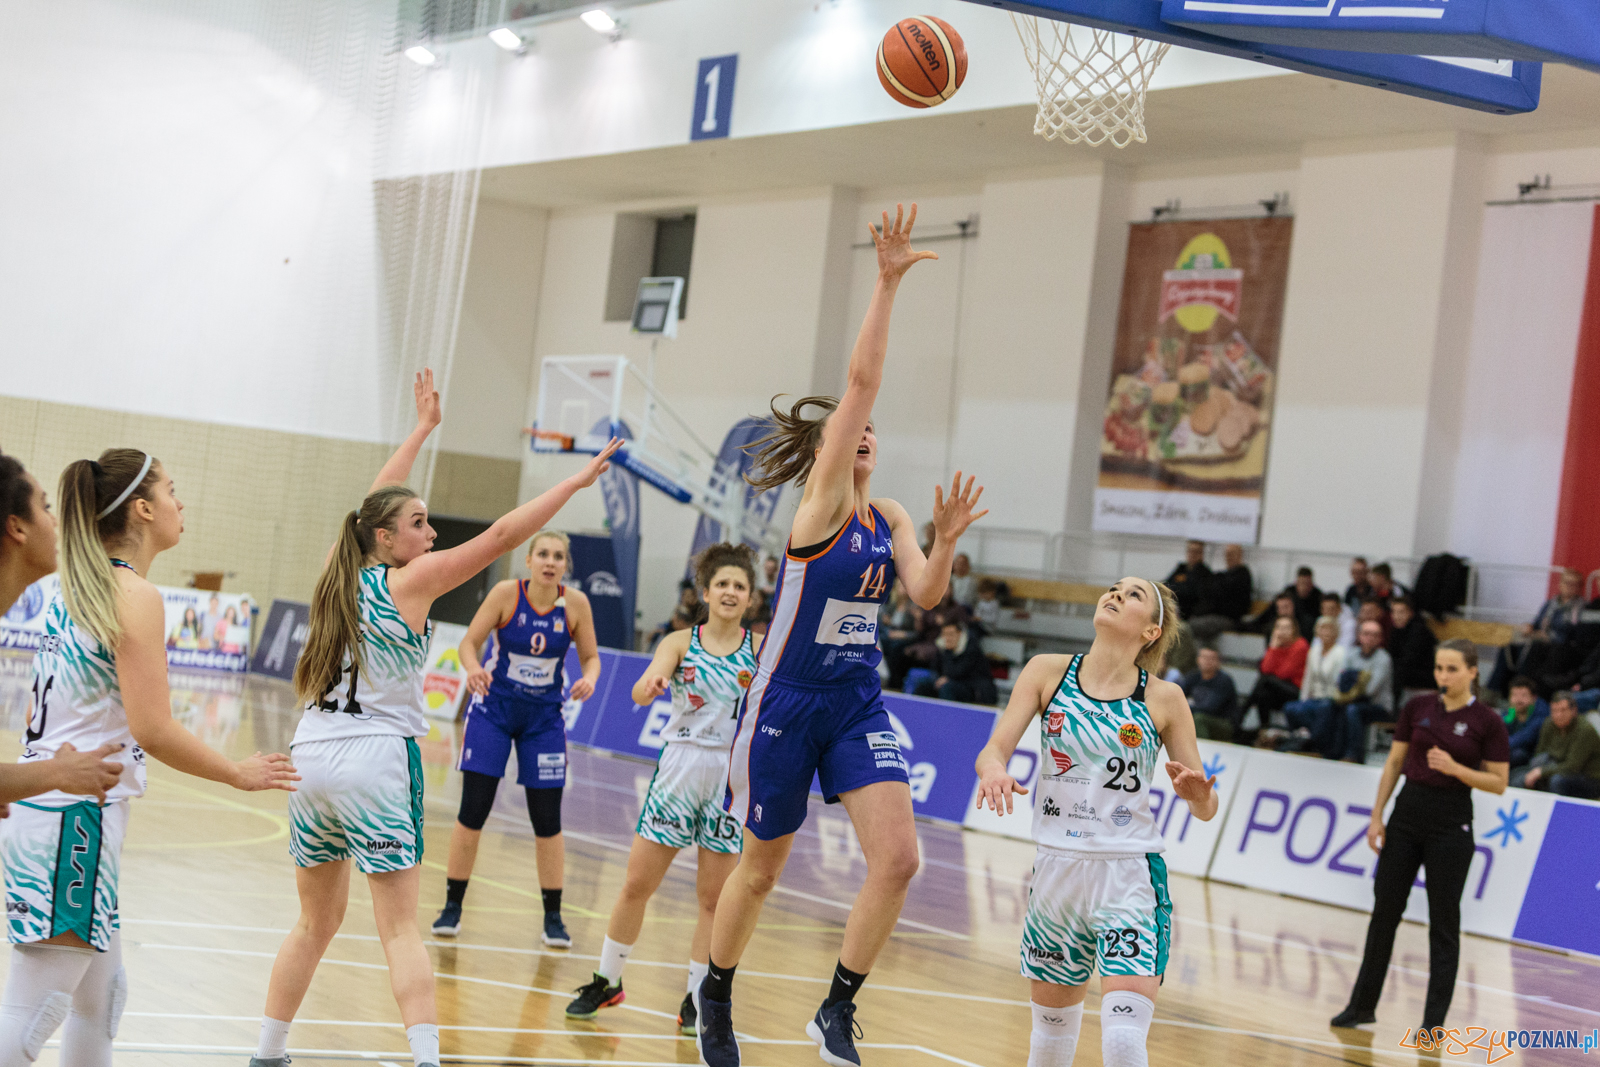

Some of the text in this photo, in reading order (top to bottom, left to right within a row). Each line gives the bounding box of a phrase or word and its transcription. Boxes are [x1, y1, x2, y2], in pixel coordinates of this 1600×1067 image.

[907, 24, 940, 71] molten
[701, 63, 721, 132] 1
[853, 563, 887, 599] 14
[530, 631, 547, 656] 9
[1102, 756, 1142, 793] 23
[713, 814, 736, 840] 15
[366, 839, 403, 852] MUKS
[1028, 945, 1065, 962] MUKS
[1104, 928, 1141, 958] 23
